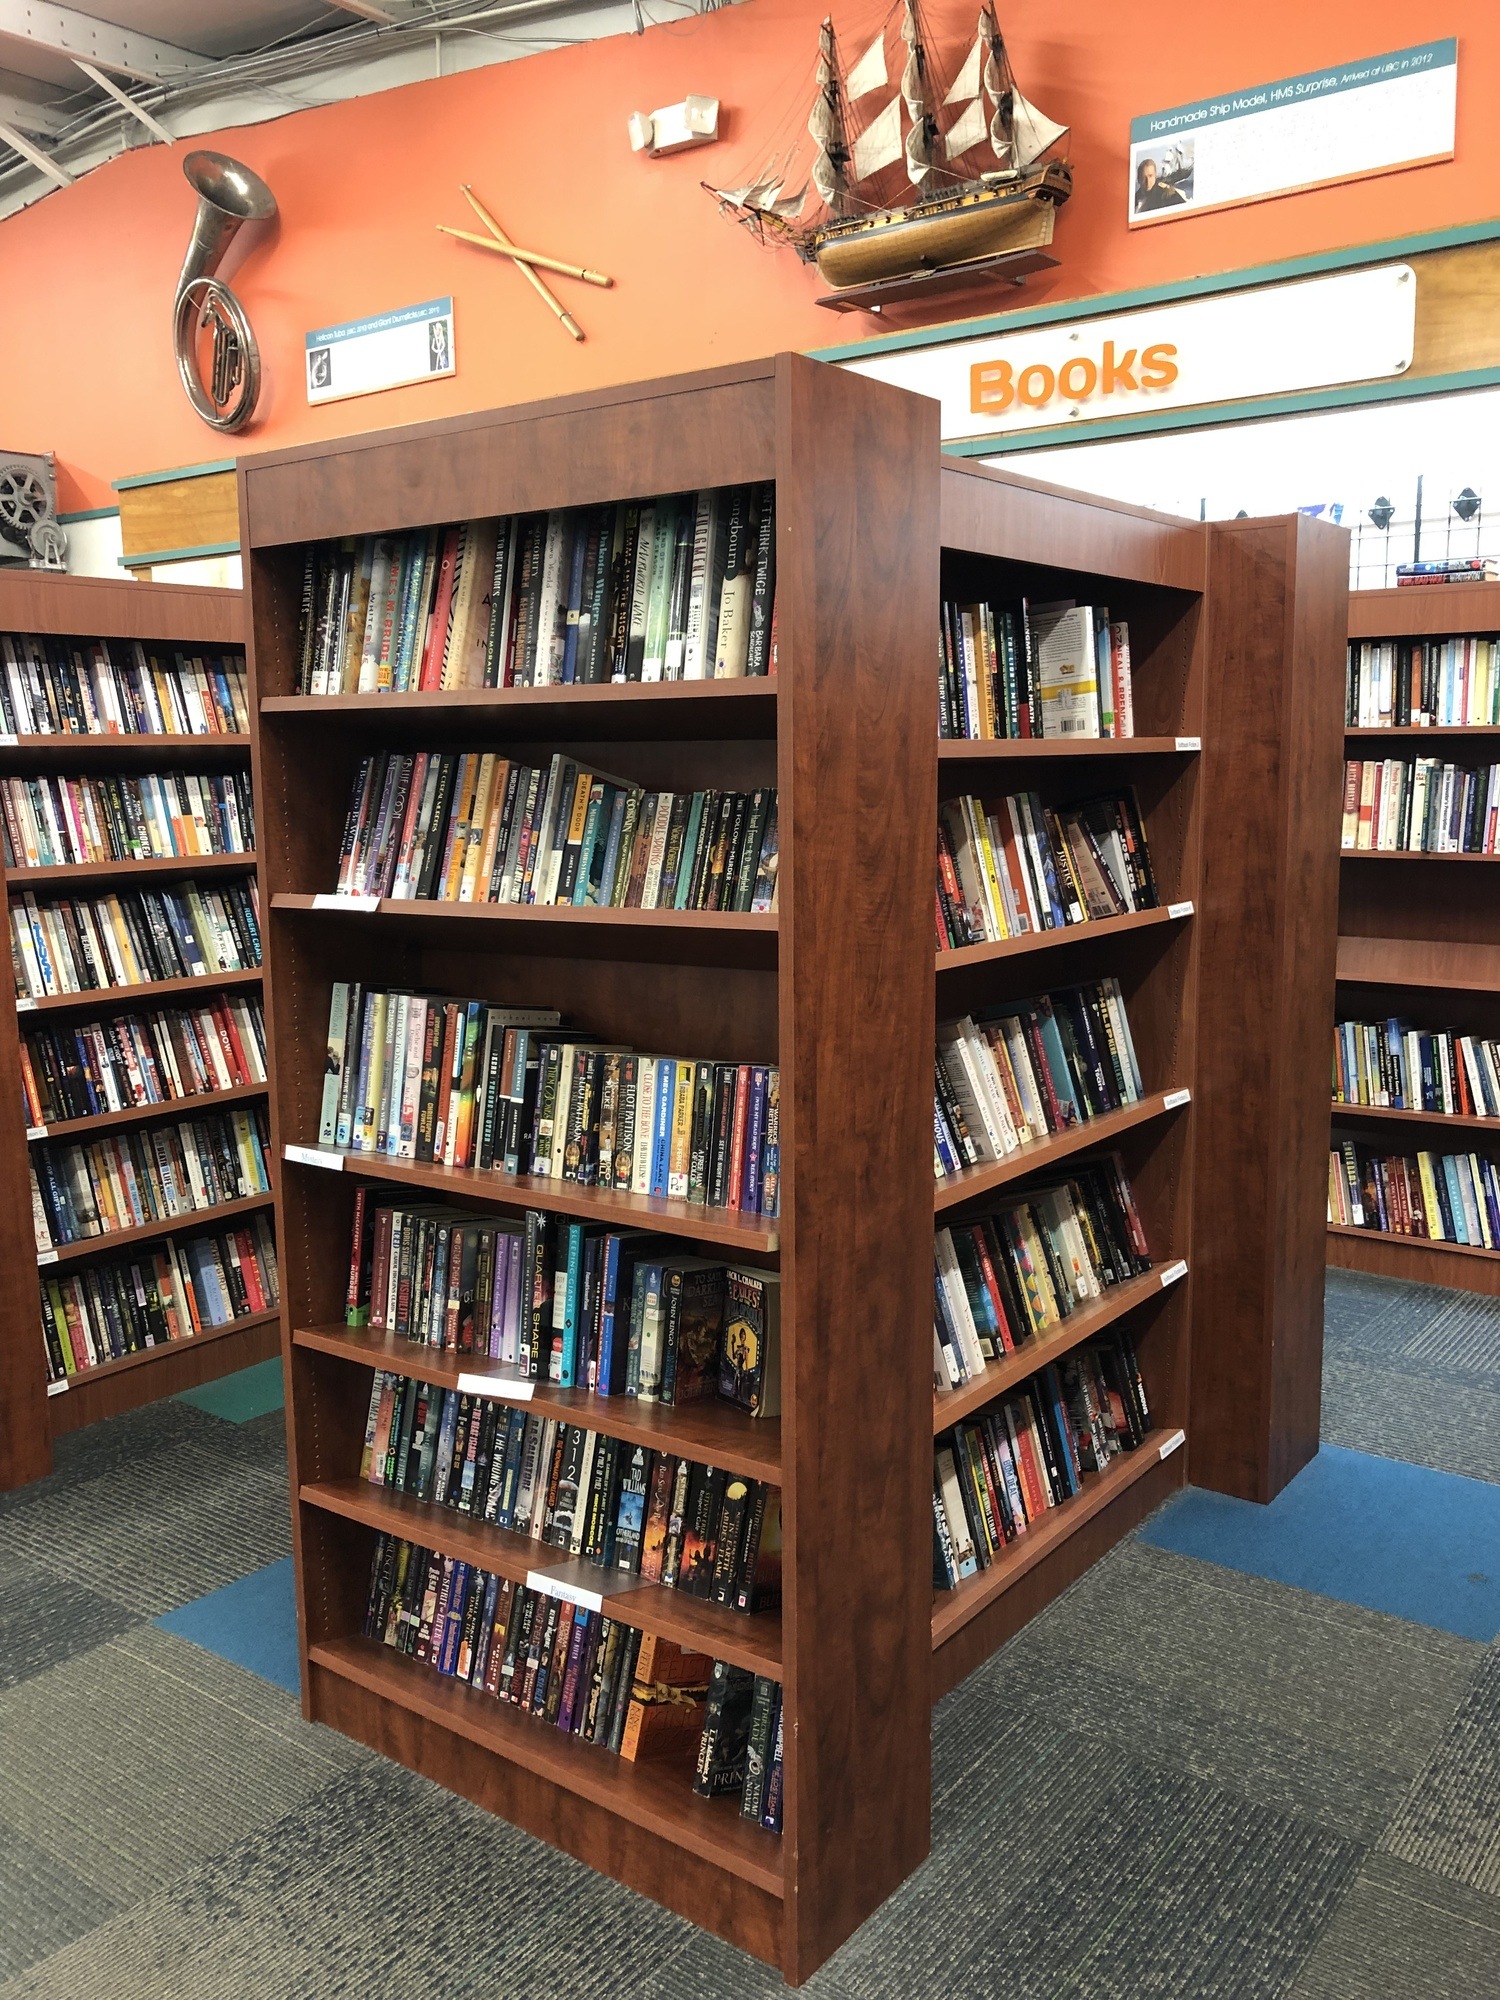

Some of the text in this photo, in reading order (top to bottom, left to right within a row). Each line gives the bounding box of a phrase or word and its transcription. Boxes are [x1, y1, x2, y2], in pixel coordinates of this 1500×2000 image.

[1150, 109, 1207, 132] Handmade
[1210, 103, 1230, 116] Ship
[1233, 93, 1268, 111] Model,
[1271, 86, 1293, 102] HMS
[1296, 76, 1338, 95] Surprise,
[1341, 69, 1370, 84] Arrived
[1371, 67, 1380, 76] at
[970, 341, 1178, 414] Books
[727, 496, 742, 569] ongbourn
[758, 516, 771, 555] THINK
[617, 612, 627, 649] NIGHT
[721, 610, 733, 648] Baker
[486, 641, 494, 673] MORAN
[938, 676, 946, 699] TERRY
[508, 770, 517, 794] MURDER
[579, 809, 597, 883] MURDER CHRISTMAS
[651, 805, 669, 865] POODLE SPRINGS
[1056, 851, 1074, 888] JUSTICE
[623, 1084, 636, 1151] ELIOT PATTISON
[642, 1106, 650, 1119] THE
[659, 1096, 667, 1137] GARDINER
[566, 1229, 577, 1313] SLEEPING GIANTS
[398, 1279, 410, 1322] VISIBILITY
[531, 1244, 543, 1358] QUARTER SHARE
[668, 1296, 678, 1346] JOHN RINGO
[495, 1433, 505, 1450] THE
[522, 1437, 539, 1491] SALVATORE
[623, 1477, 646, 1494] WILLIAMS
[715, 1549, 725, 1579] FLAME
[723, 1540, 732, 1571] EARTH
[550, 1585, 577, 1602] Fantasy
[751, 1718, 760, 1743] JADE
[743, 1780, 753, 1813] NOVIK
[750, 1783, 760, 1816] NAOMI
